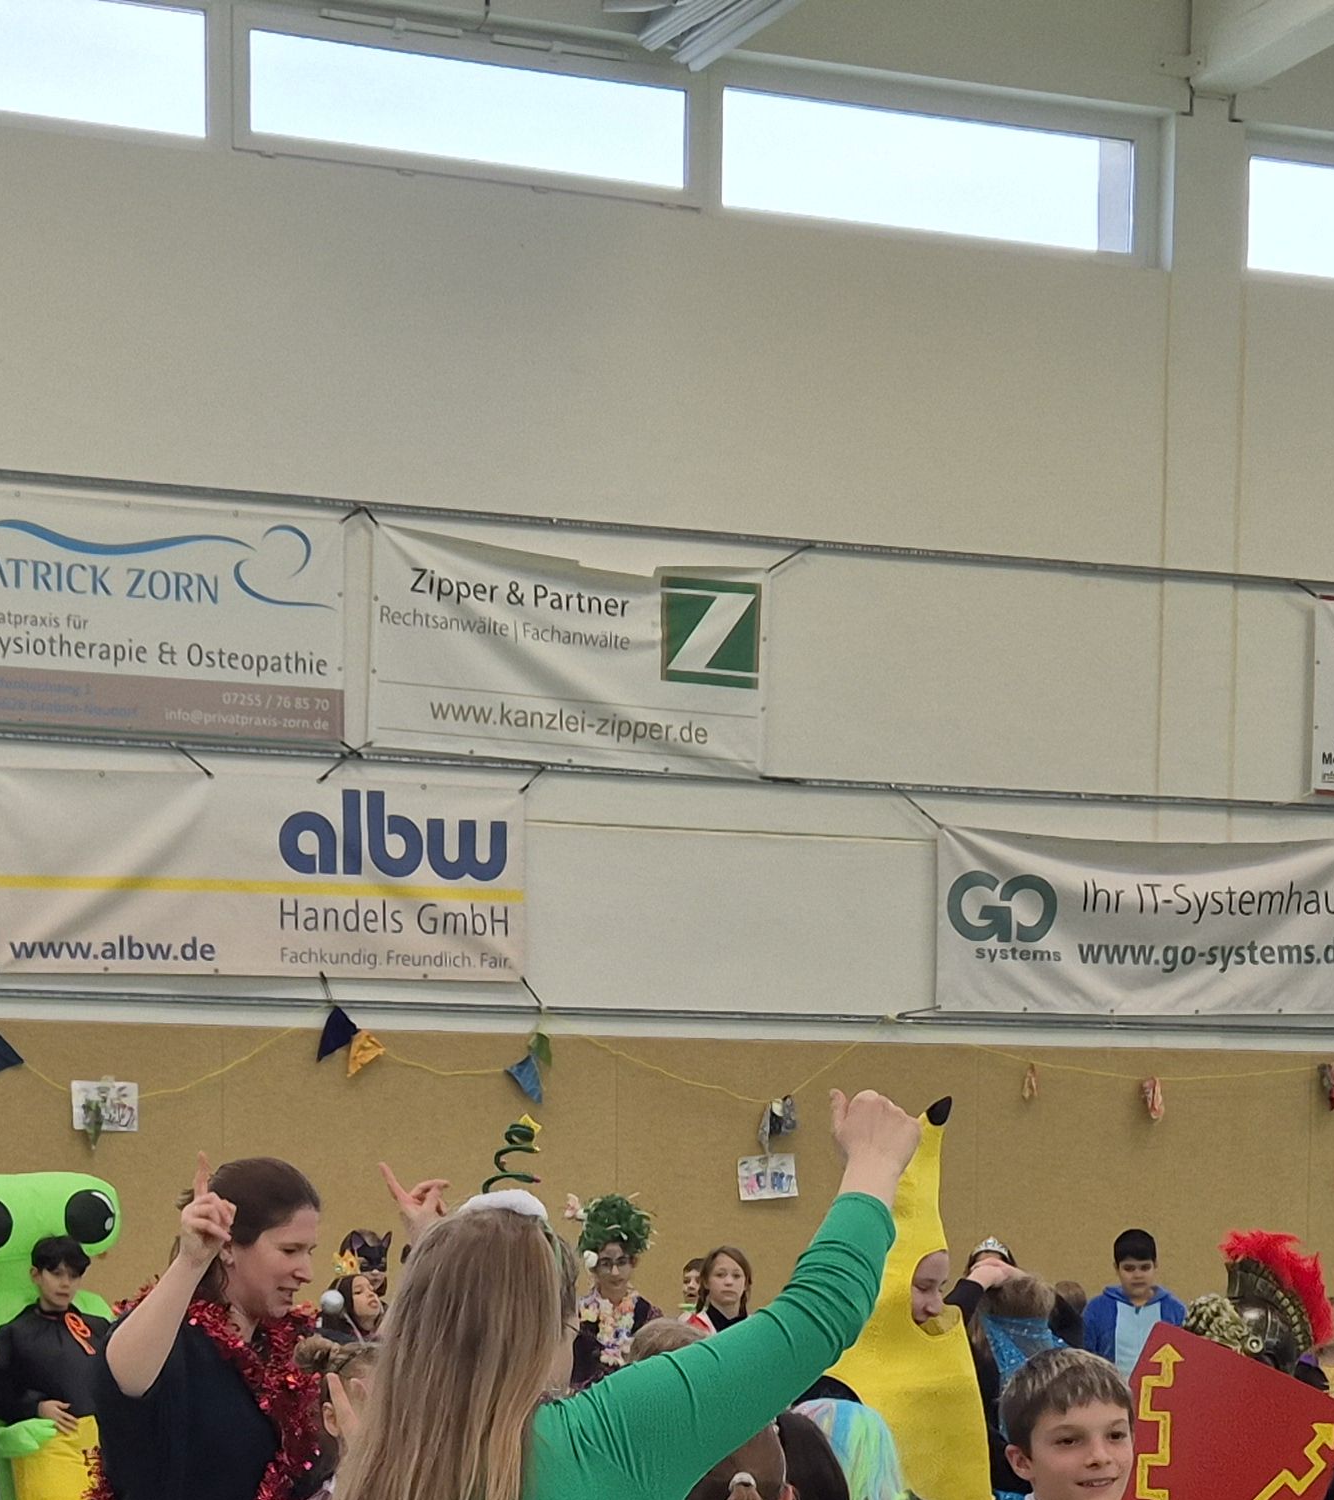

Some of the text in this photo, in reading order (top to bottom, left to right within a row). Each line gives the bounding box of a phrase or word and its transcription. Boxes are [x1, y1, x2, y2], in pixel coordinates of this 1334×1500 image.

[125, 567, 219, 605] ZORN
[410, 566, 631, 618] Zipper & Partner
[66, 612, 89, 632] für
[379, 604, 510, 638] Rechtsanwälte
[522, 622, 631, 651] Fachanwälte
[158, 642, 178, 666] &
[186, 643, 329, 678] Osteopathie
[165, 708, 330, 731] info@privatpraxis-zorn.de
[222, 691, 261, 707] 07255
[276, 695, 291, 709] 76
[294, 697, 310, 711] 85
[314, 698, 330, 712] 70
[430, 701, 709, 745] www.kanzlei-zipper.de
[278, 788, 509, 883] albw
[946, 869, 1059, 944] GO
[1081, 878, 1126, 915] Ihr
[279, 897, 511, 938] Handels GmbH
[9, 934, 217, 963] www.albw.de
[279, 945, 514, 971] Fachkundig. Freundlich. Fair.
[975, 944, 1063, 965] systems
